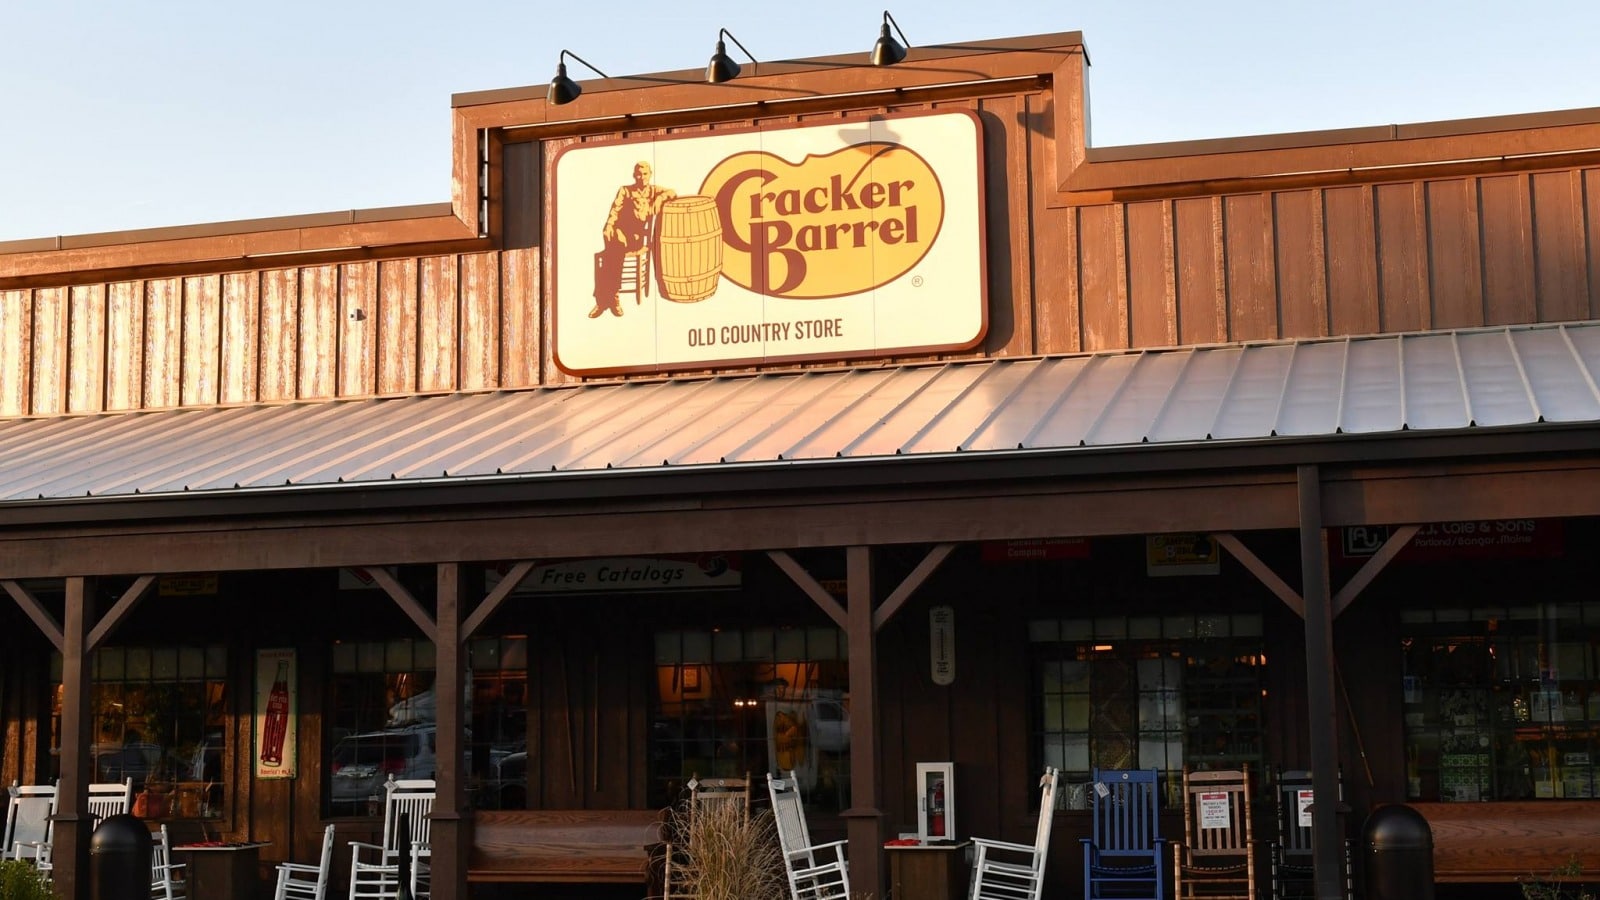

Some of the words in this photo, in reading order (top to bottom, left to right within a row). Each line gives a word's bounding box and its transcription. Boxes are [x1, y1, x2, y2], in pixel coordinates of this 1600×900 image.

[714, 168, 915, 252] Cracker
[748, 220, 918, 296] Barrel
[688, 328, 716, 347] OLD
[721, 322, 791, 344] COUNTRY
[795, 318, 843, 340] STORE
[1479, 521, 1491, 533] &
[1496, 519, 1536, 532] Sons
[1007, 547, 1047, 560] Company
[541, 568, 586, 584] Free
[597, 565, 685, 585] Catalogs
